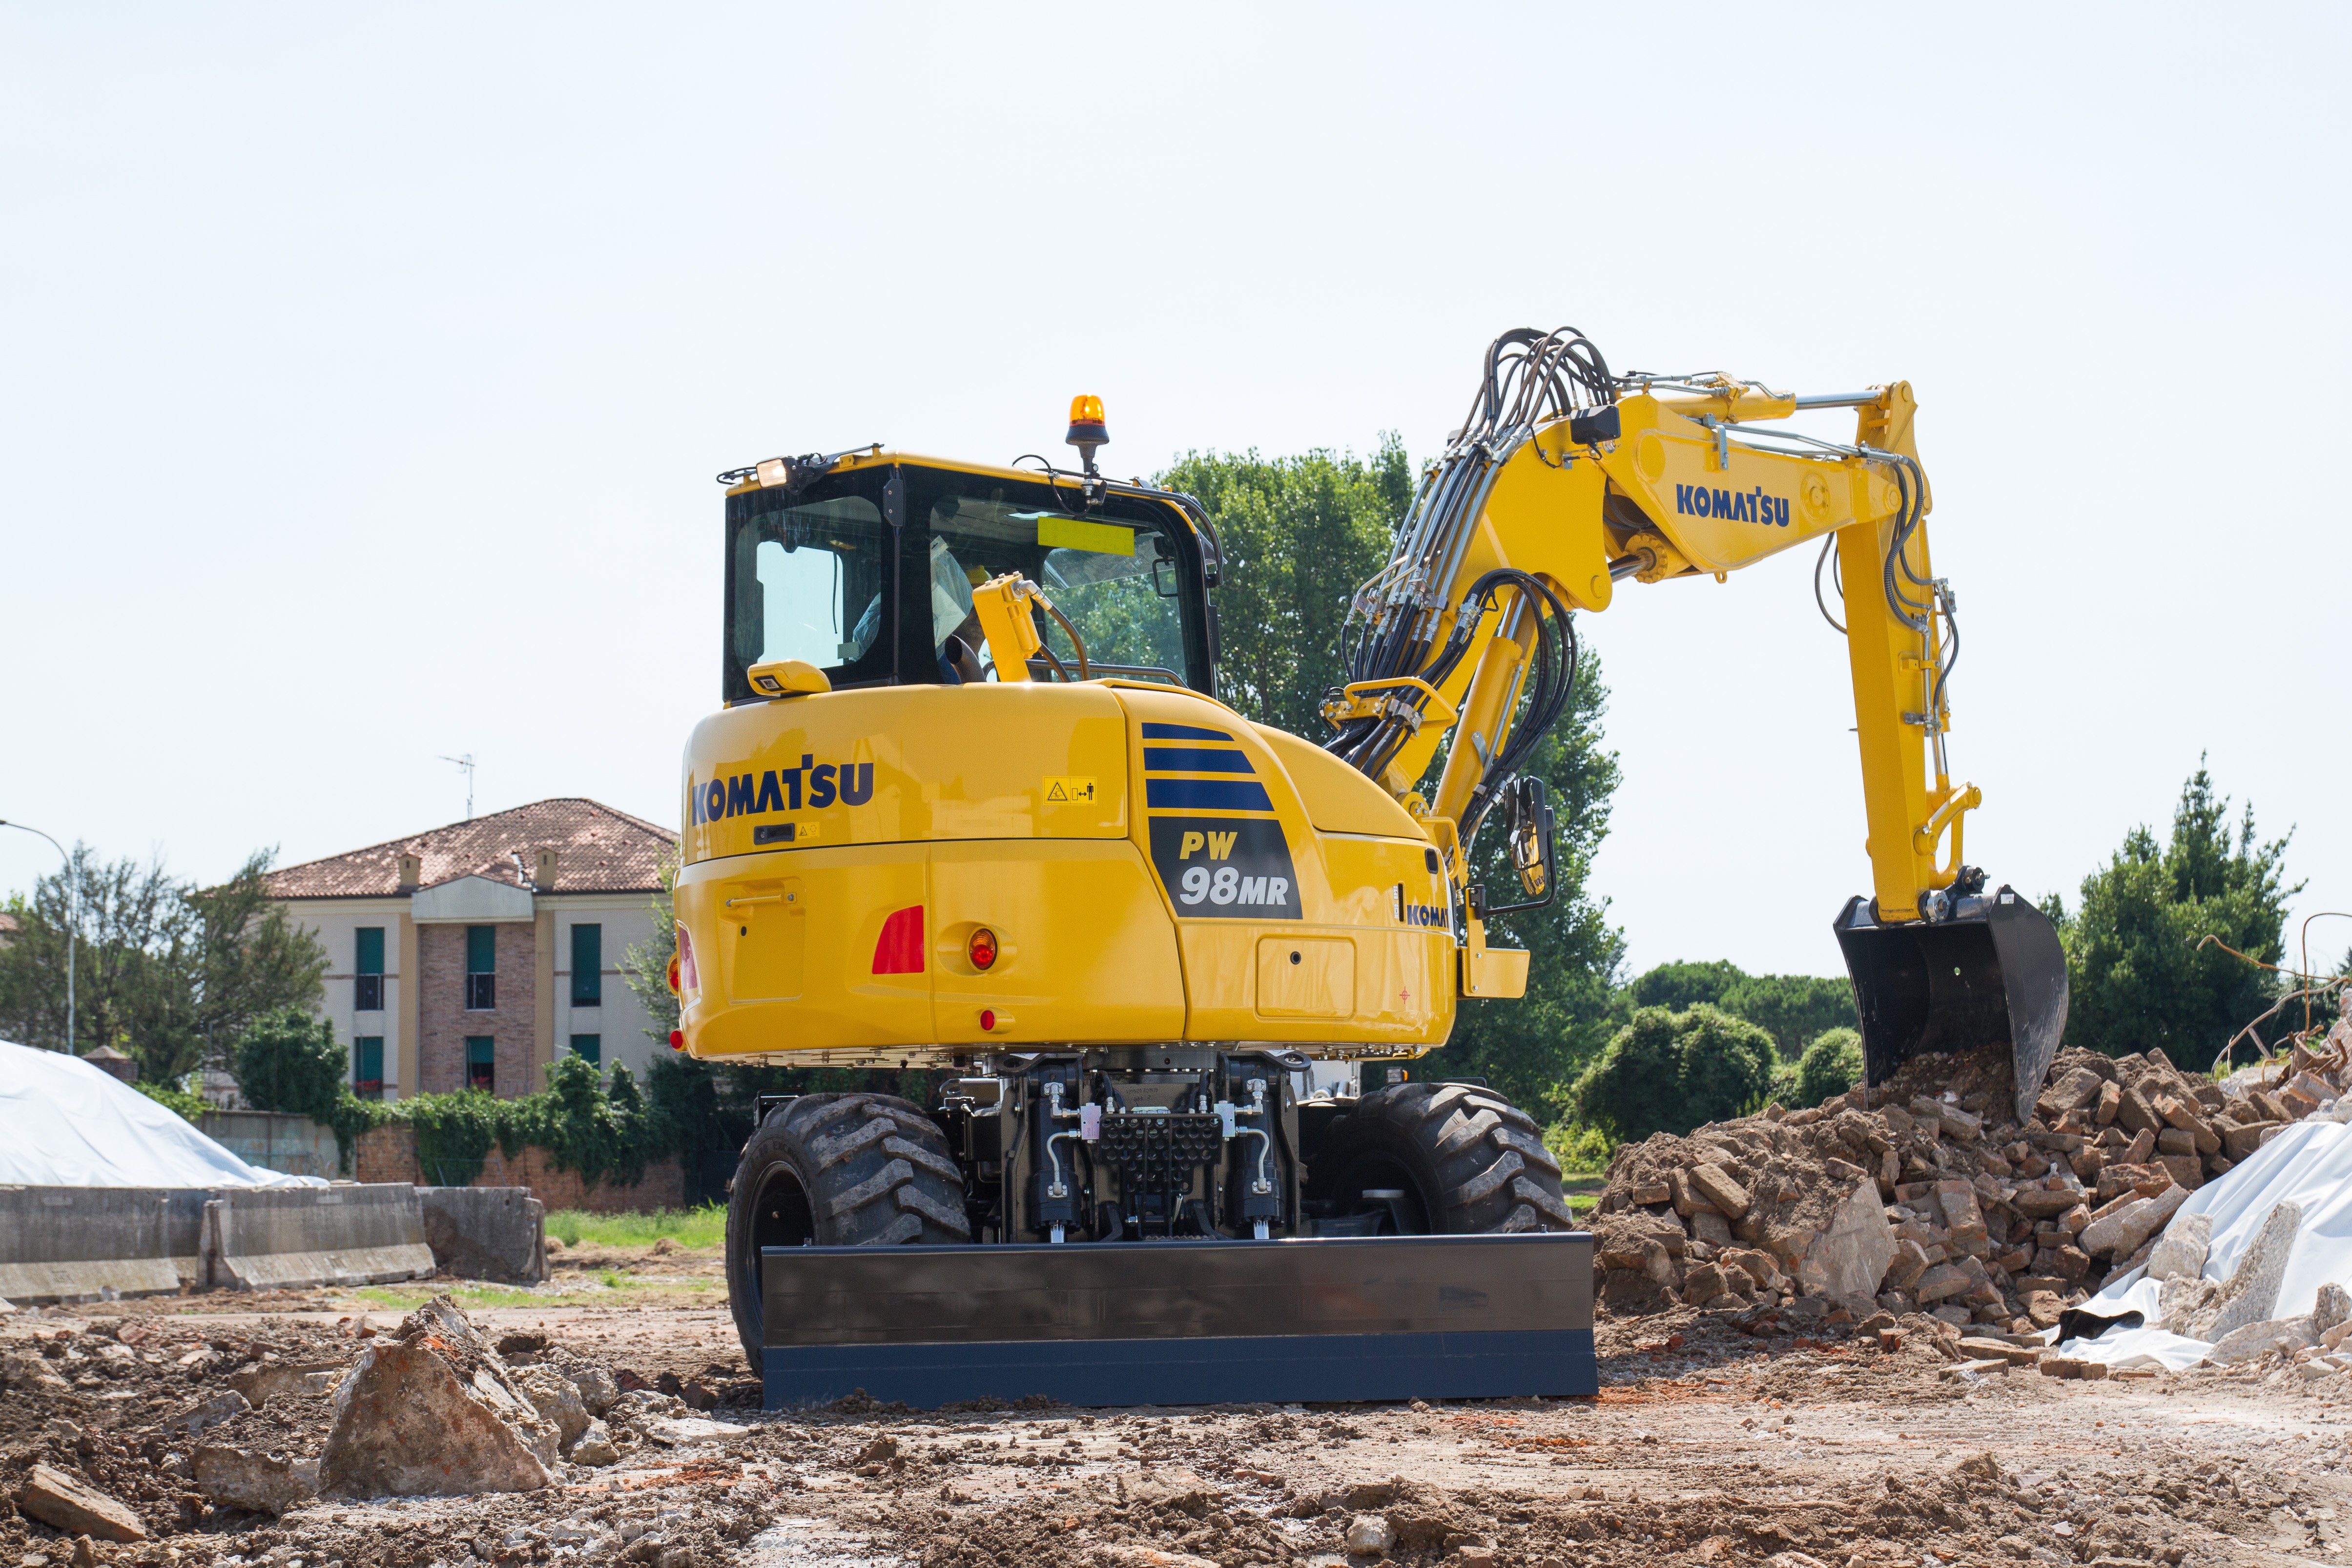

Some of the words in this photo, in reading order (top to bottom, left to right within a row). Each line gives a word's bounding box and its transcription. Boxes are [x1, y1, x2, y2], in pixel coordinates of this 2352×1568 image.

[1676, 484, 1790, 527] KOMATSU
[692, 754, 874, 827] KOMATSU
[1179, 831, 1238, 860] PW
[1179, 867, 1289, 905] 98MR
